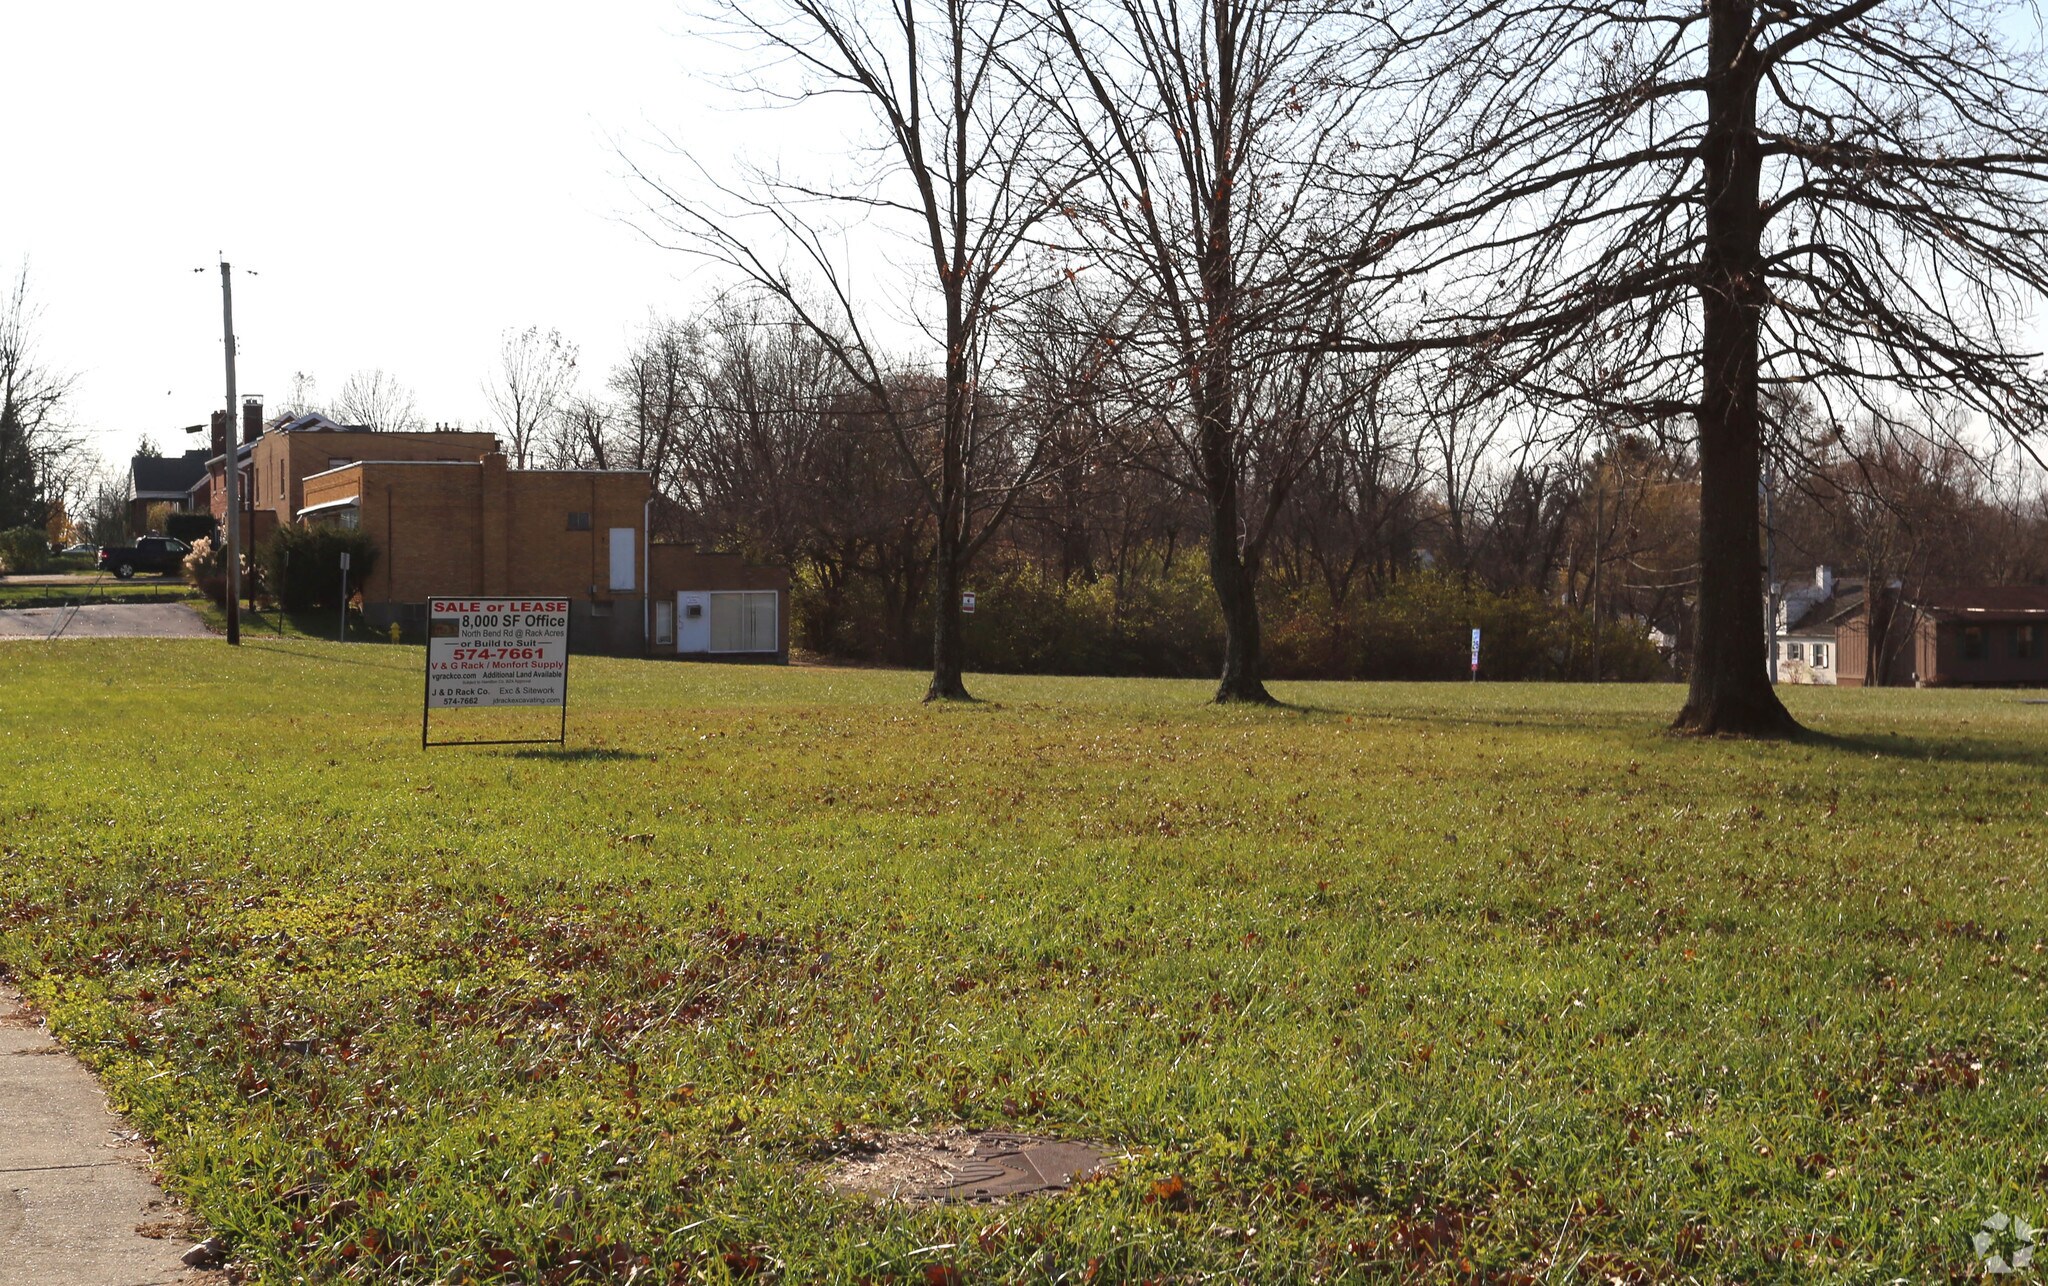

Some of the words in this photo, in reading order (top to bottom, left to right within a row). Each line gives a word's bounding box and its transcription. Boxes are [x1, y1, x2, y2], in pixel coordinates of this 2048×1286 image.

[434, 602, 480, 612] SALE
[486, 604, 505, 612] or
[510, 602, 567, 612] LEASE
[462, 614, 498, 629] 8,000
[502, 614, 521, 627] SF
[525, 614, 565, 627] Office
[461, 629, 481, 637] North
[483, 629, 501, 637] Bend
[503, 629, 513, 637] Rd
[515, 629, 523, 639] @
[525, 629, 542, 637] Rack
[544, 629, 564, 637] Acres
[516, 639, 536, 647] Suit
[453, 648, 544, 660] 574-7661
[431, 662, 438, 670] V
[441, 662, 447, 670] &
[461, 661, 484, 669] Rack
[492, 661, 528, 669] Monfort
[531, 660, 564, 670] Supply
[432, 672, 477, 681] vgrackco.com
[482, 670, 515, 678] Additional
[533, 670, 562, 678] Available
[455, 688, 475, 696] Rack
[523, 686, 555, 694] Sitework
[443, 697, 478, 705] 574-7662
